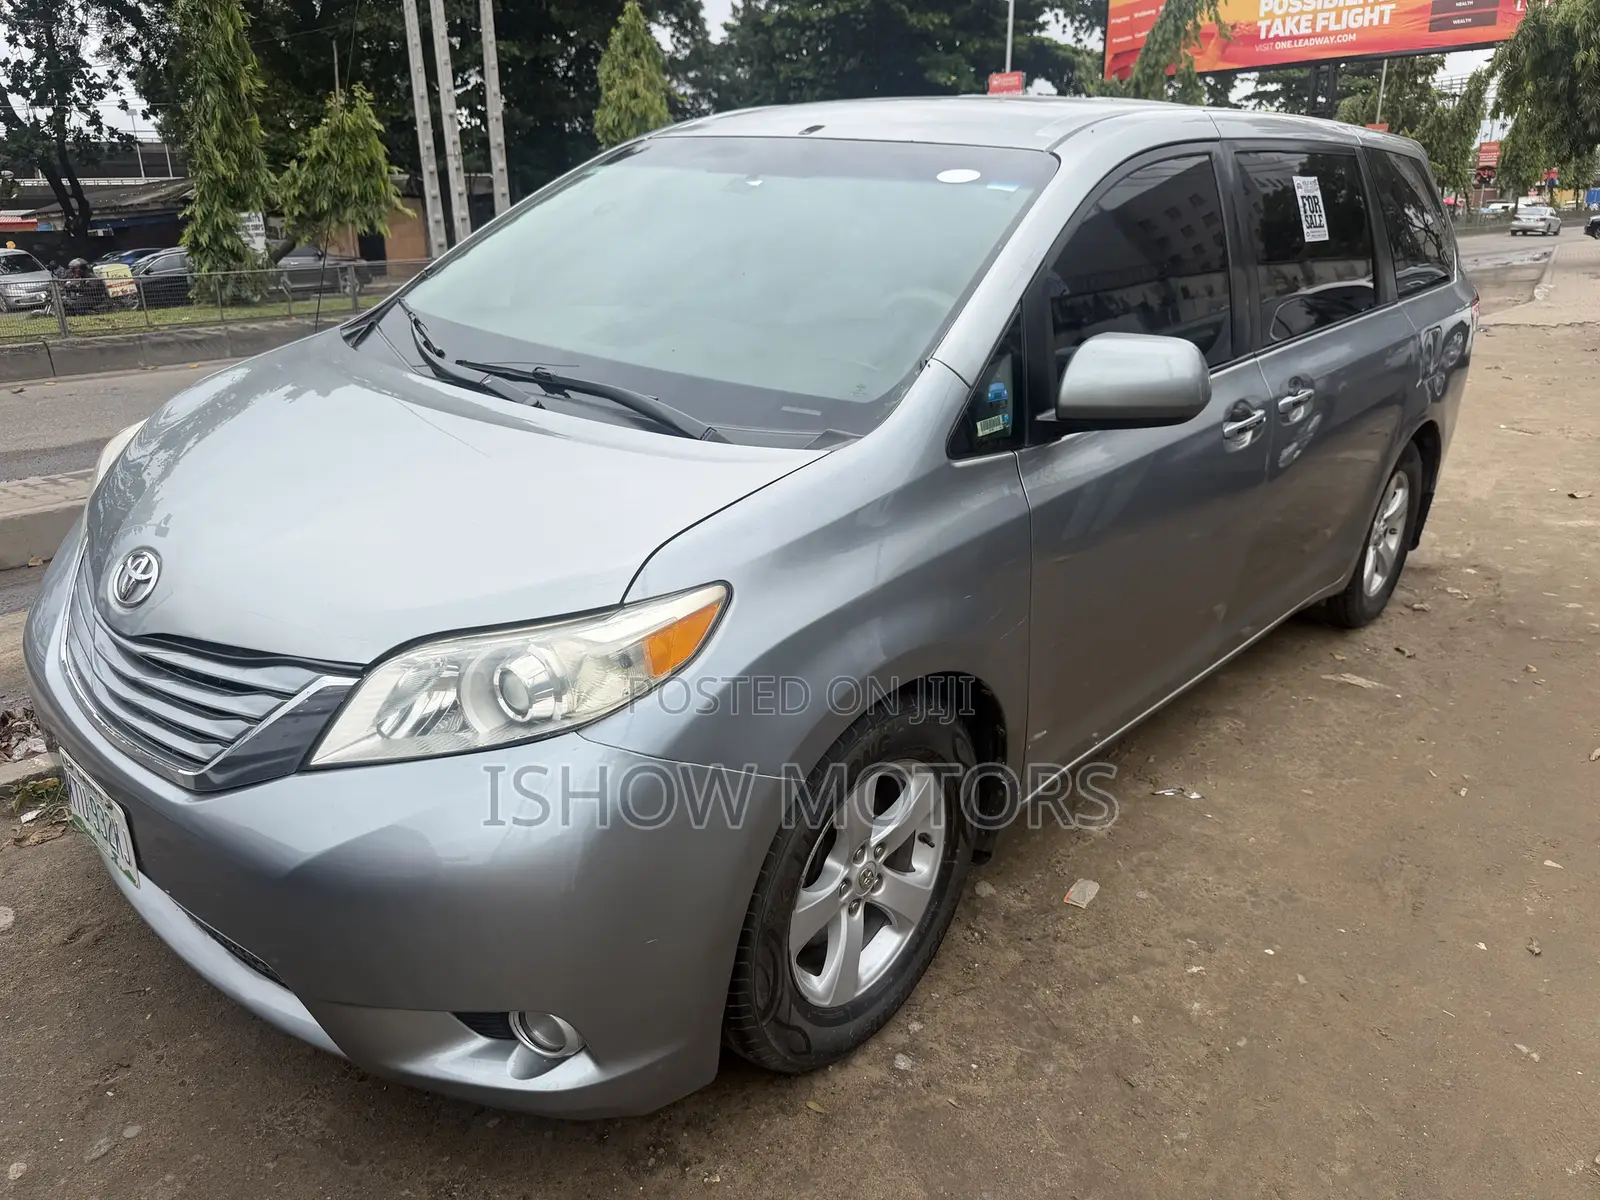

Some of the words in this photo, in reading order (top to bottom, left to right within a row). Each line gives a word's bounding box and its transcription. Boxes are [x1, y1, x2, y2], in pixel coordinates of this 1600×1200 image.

[1257, 14, 1313, 40] TAKE
[1316, 3, 1396, 33] FLIGHT
[1255, 42, 1273, 52] VISIT
[1275, 33, 1357, 50] ONE.LEADWAY.COM
[1300, 195, 1322, 214] FOR
[1304, 214, 1325, 229] SALE
